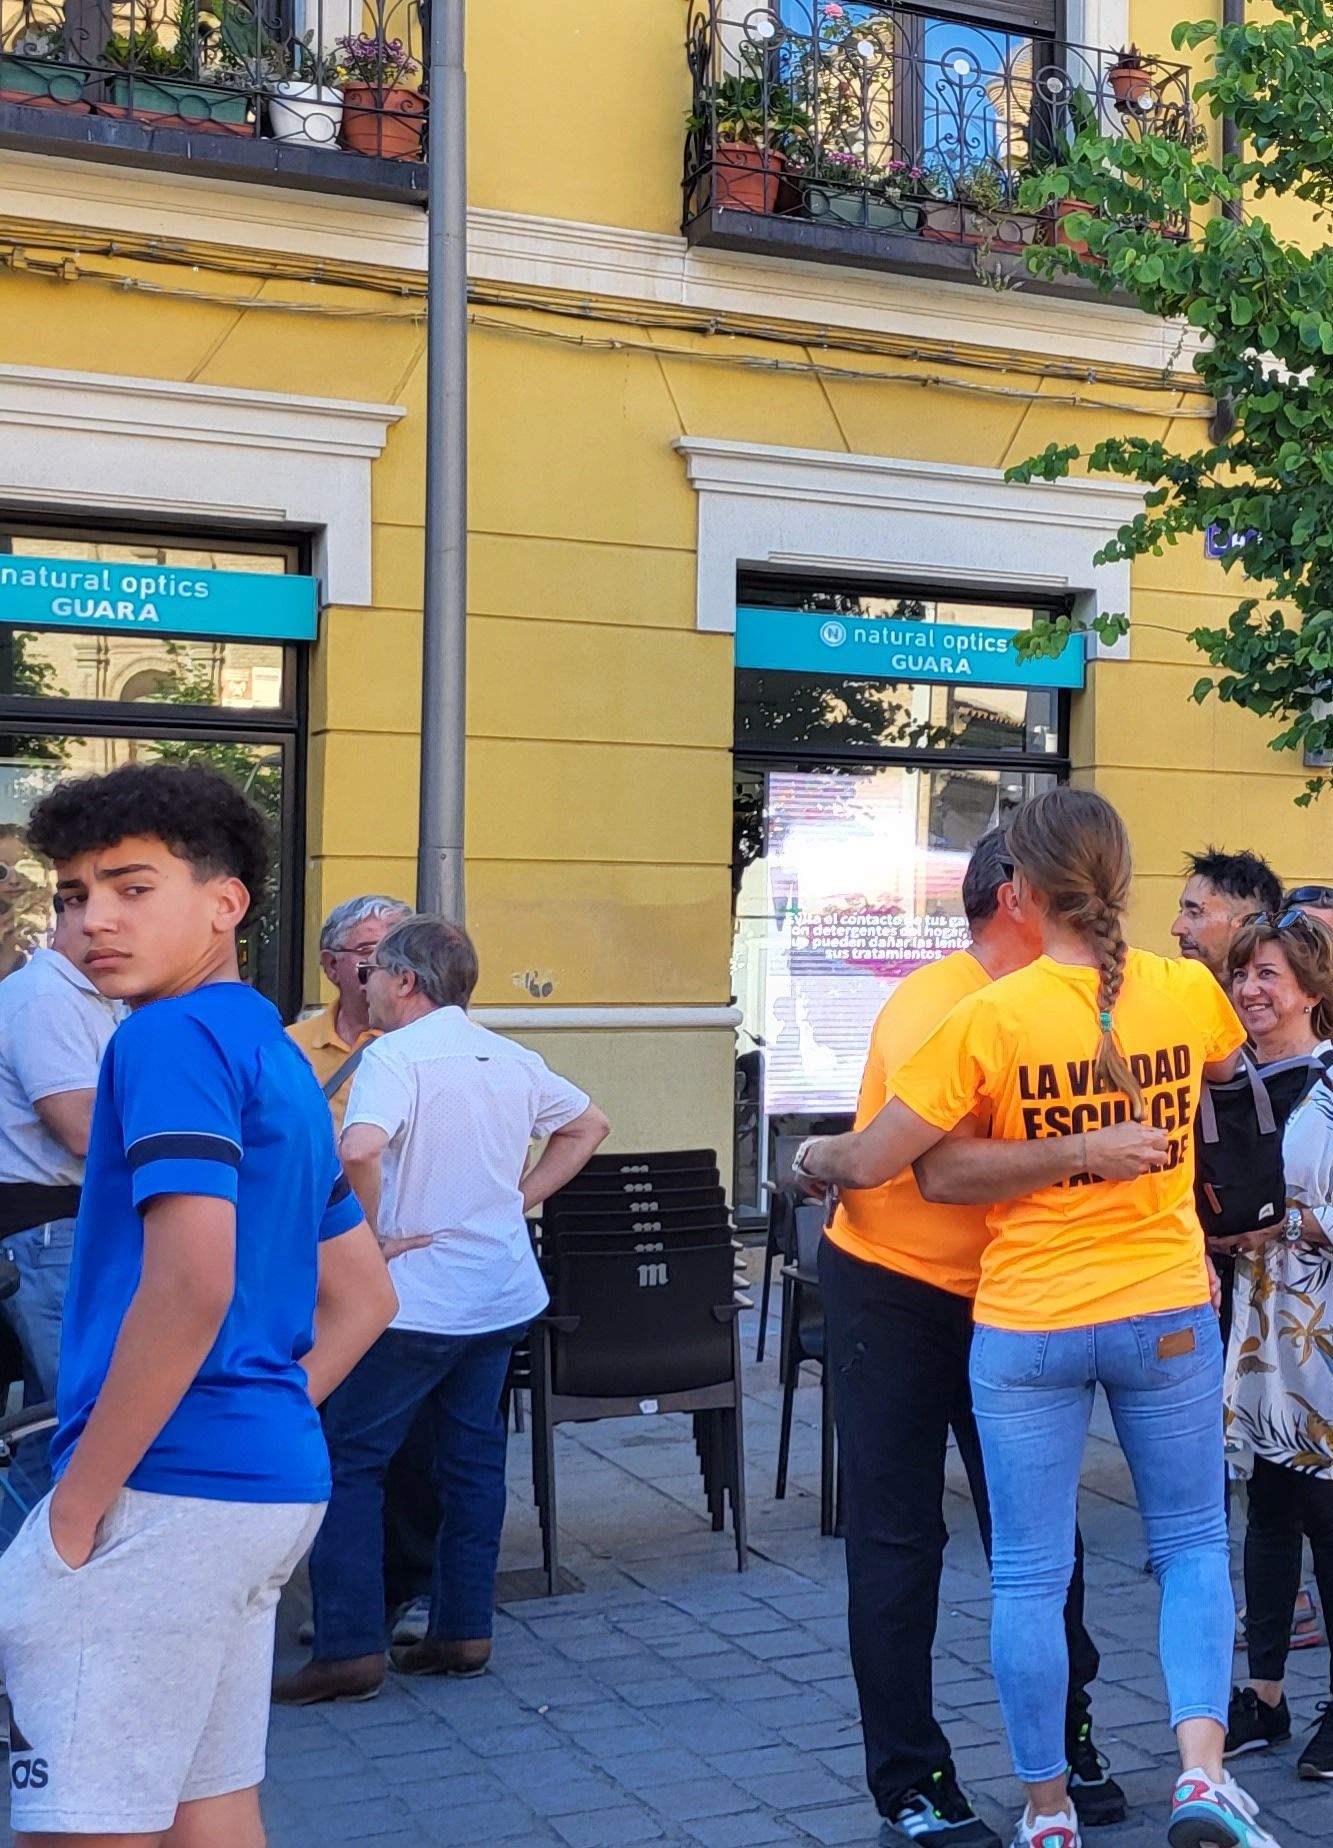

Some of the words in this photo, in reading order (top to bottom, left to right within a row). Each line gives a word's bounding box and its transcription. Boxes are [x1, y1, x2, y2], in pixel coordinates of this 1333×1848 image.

[1, 566, 110, 592] natural
[121, 575, 209, 600] optics
[52, 597, 160, 623] GUARA
[854, 627, 935, 649] natural
[944, 634, 1009, 655] optics
[892, 655, 972, 675] GUARA
[813, 924, 898, 938] detergentes
[840, 912, 902, 926] contacto
[813, 936, 866, 950] pueden
[935, 936, 973, 950] lente
[1018, 1064, 1060, 1100] LA
[1022, 1085, 1191, 1141] ESCUCE
